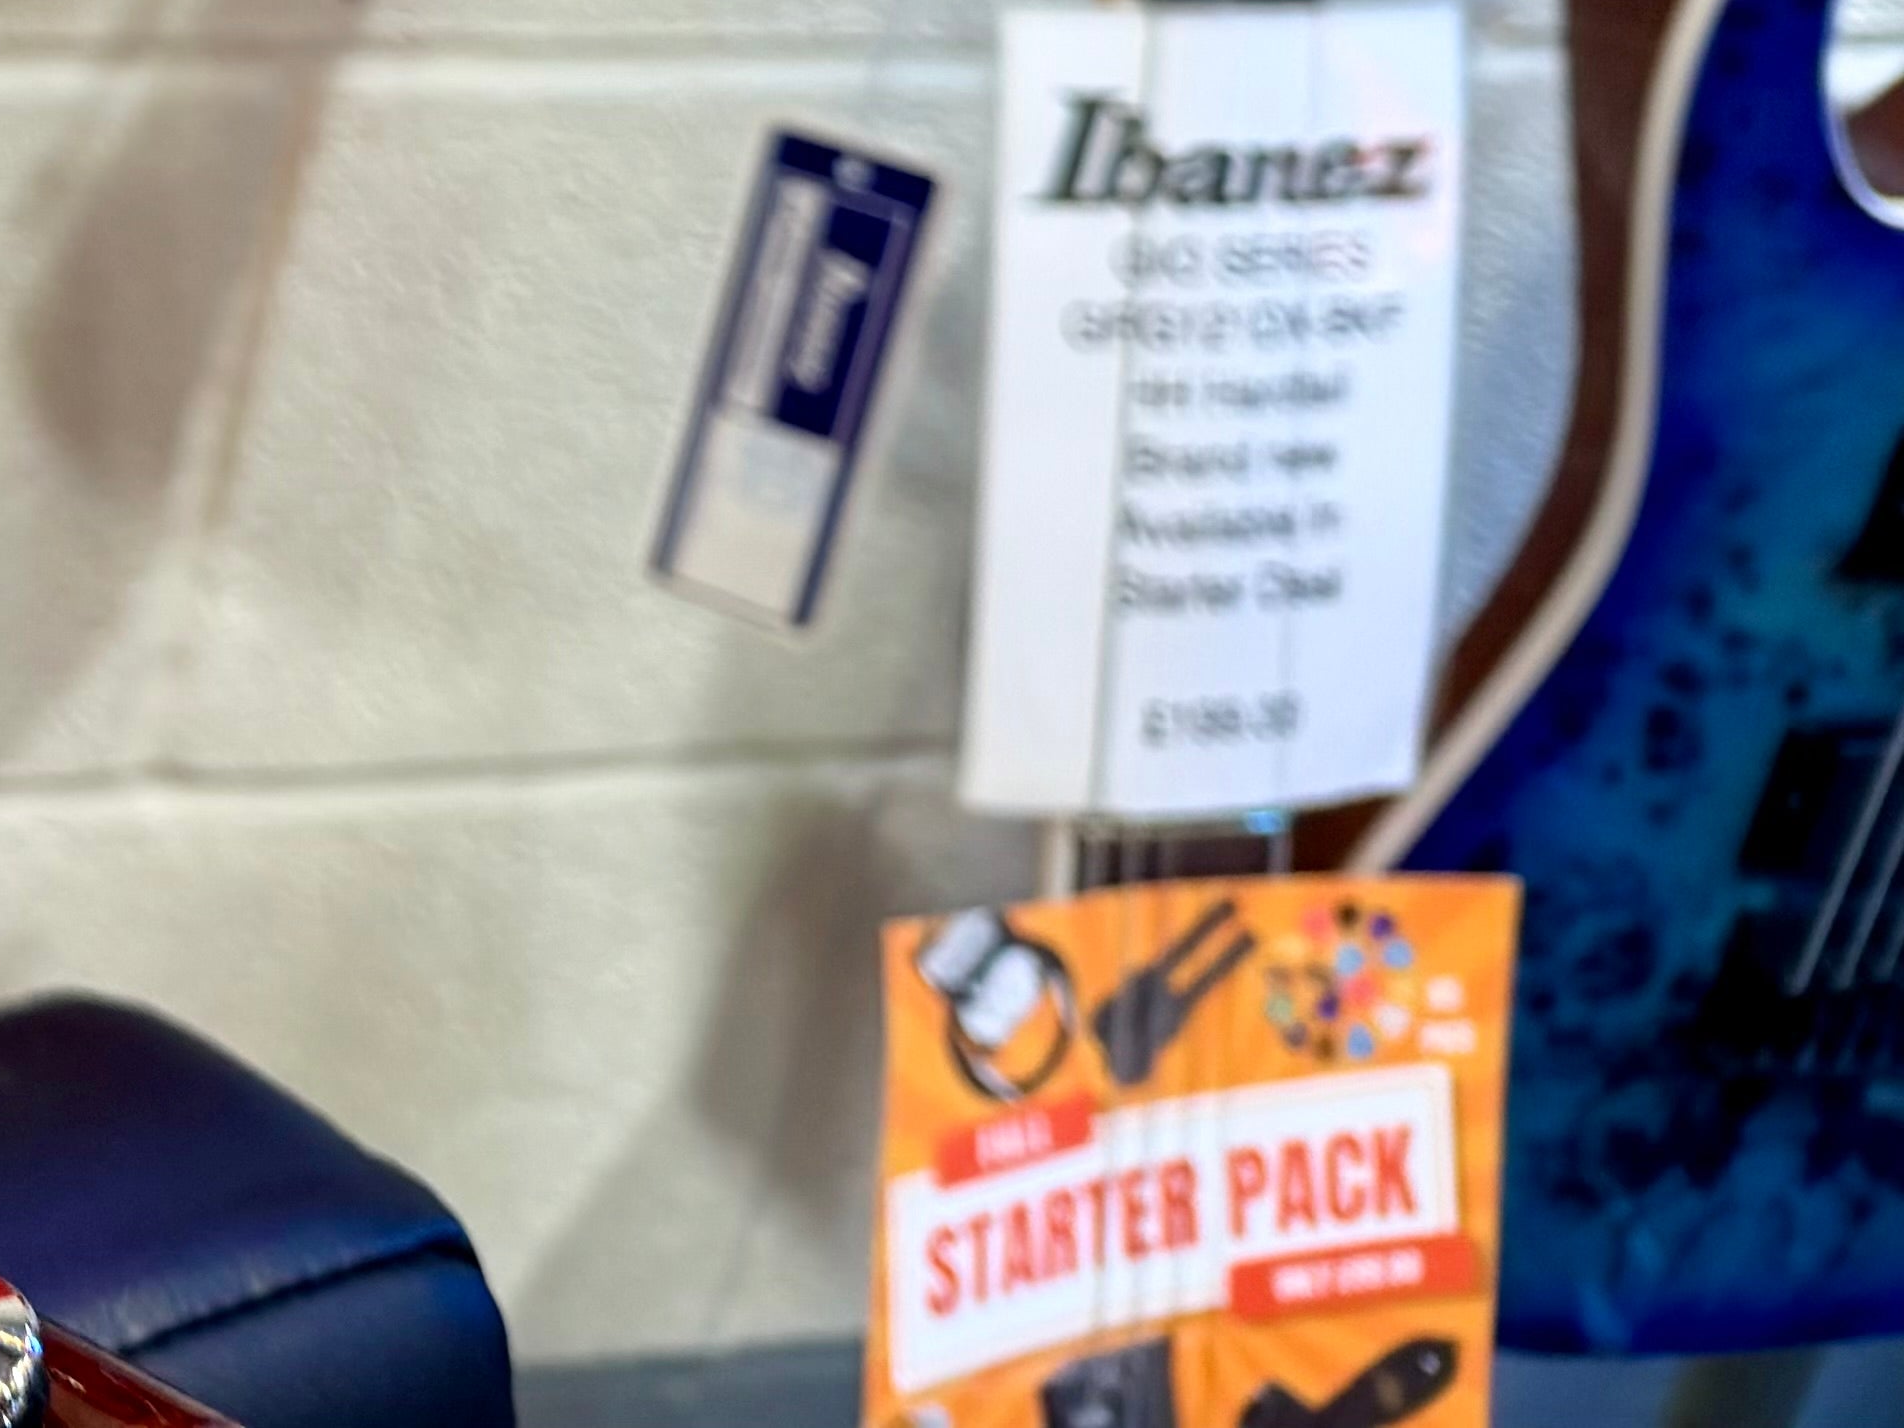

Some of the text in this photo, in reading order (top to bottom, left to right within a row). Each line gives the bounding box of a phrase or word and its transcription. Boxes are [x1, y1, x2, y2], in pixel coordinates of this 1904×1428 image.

[1025, 90, 1435, 206] Ibanez
[925, 1158, 1200, 1320] STARTER
[1225, 1123, 1416, 1240] PACK
